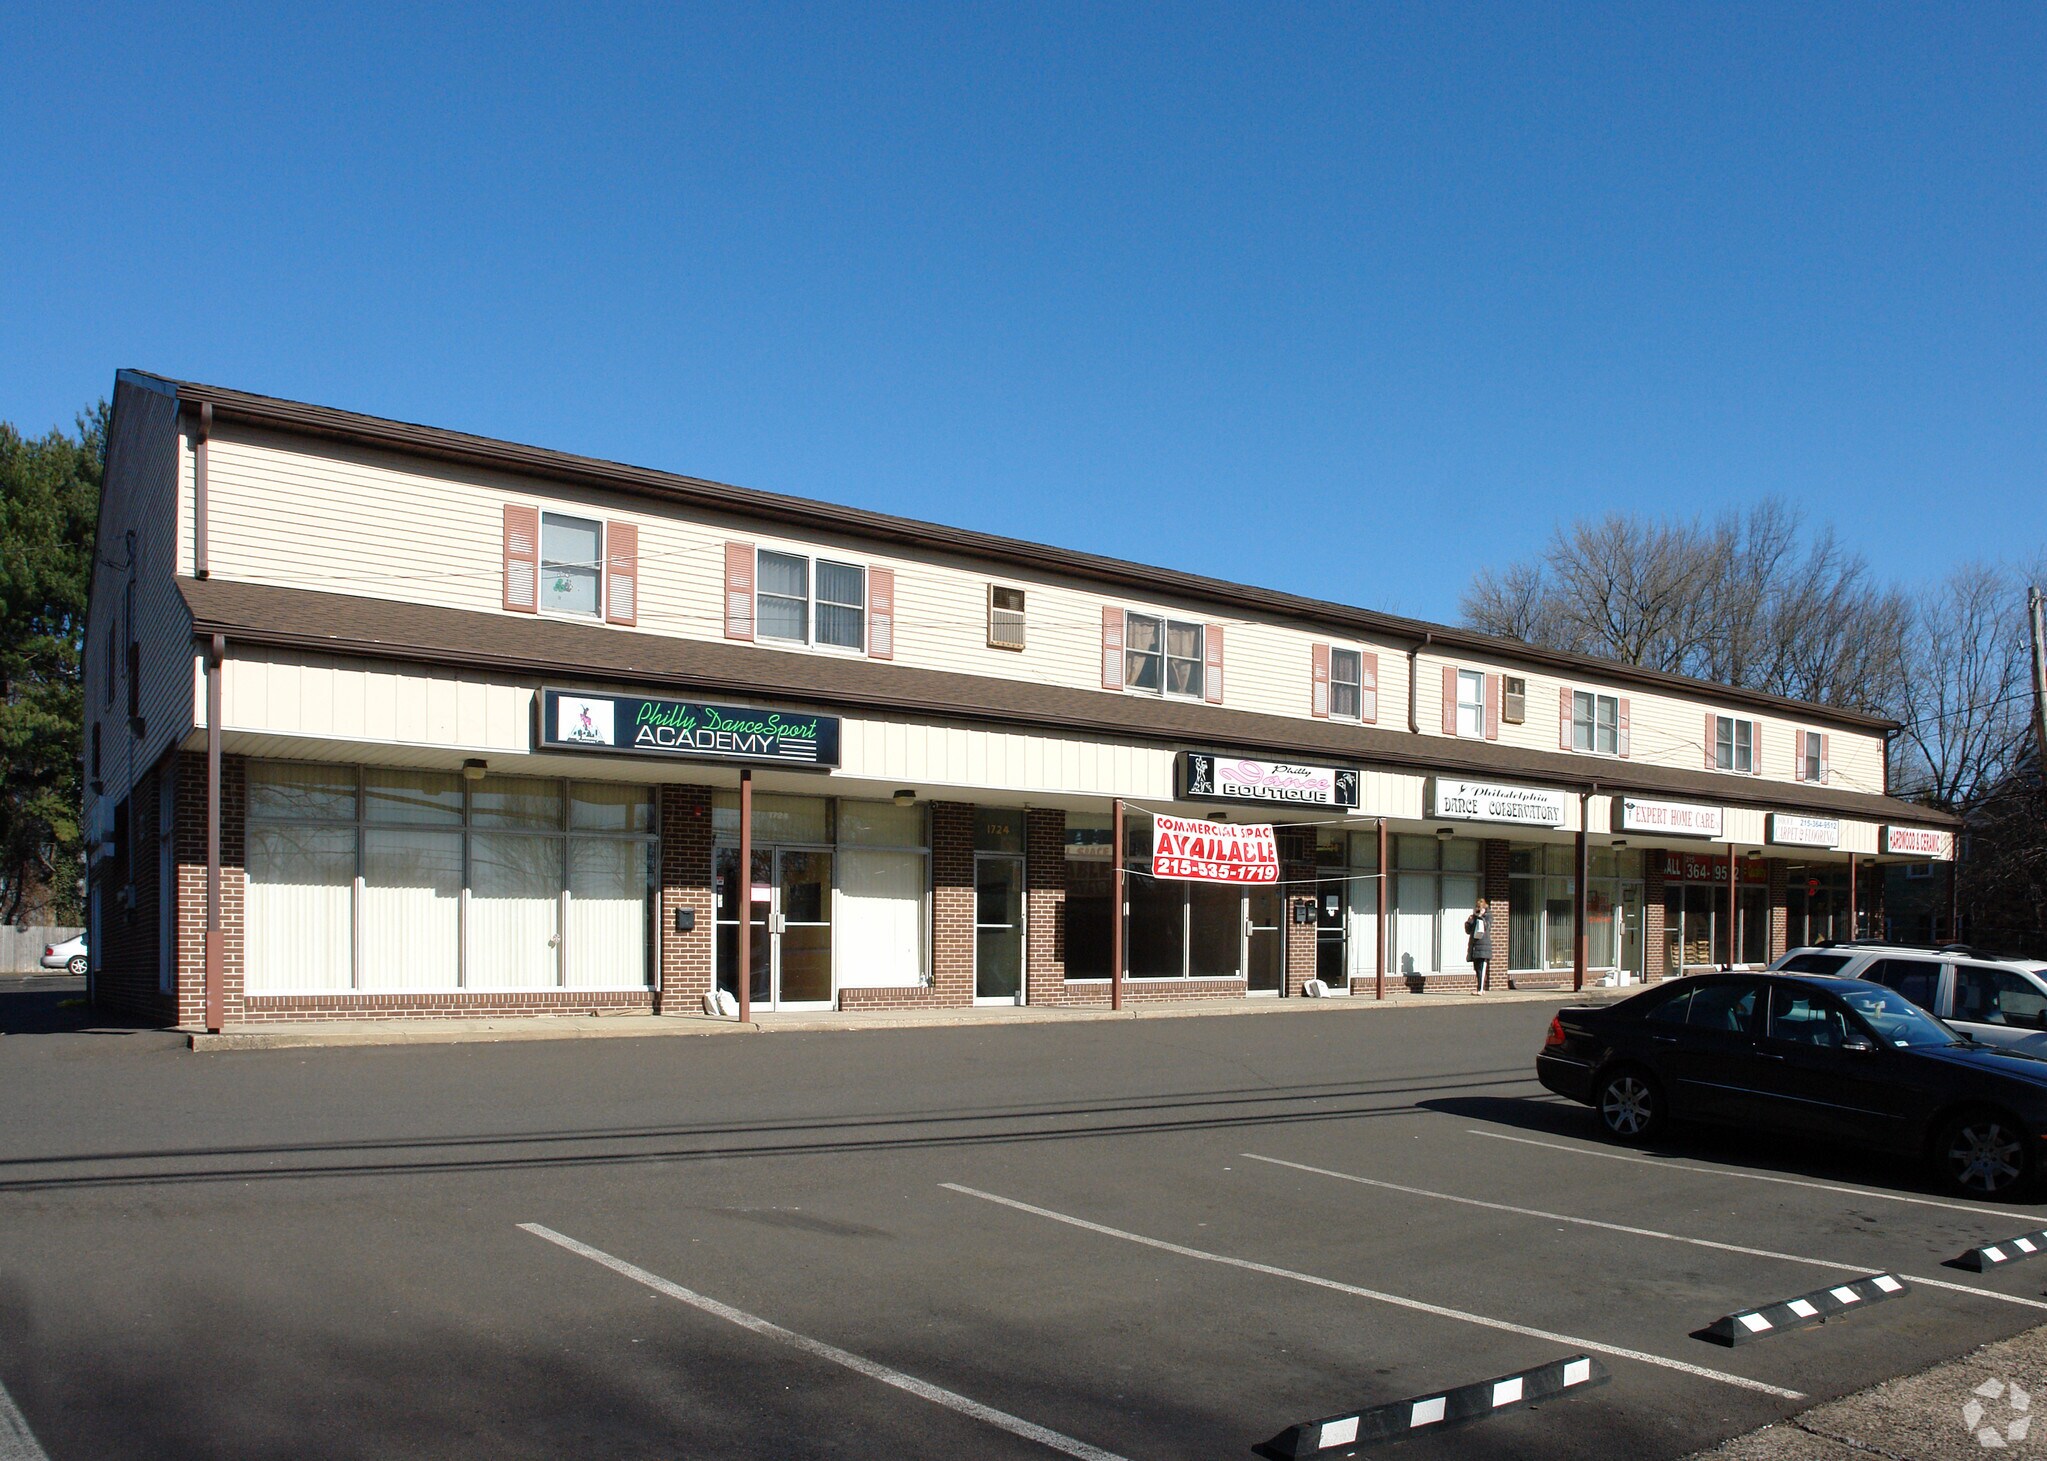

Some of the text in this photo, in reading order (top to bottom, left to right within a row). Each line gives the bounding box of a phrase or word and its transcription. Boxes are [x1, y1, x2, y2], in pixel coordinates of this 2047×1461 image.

[636, 702, 817, 743] Philly DanceSport
[635, 725, 774, 752] ACADEMY
[1219, 760, 1331, 790] Dance
[1271, 765, 1311, 777] Philly
[1223, 783, 1327, 802] BOUTIQUE
[1471, 786, 1548, 802] Philadelphia
[1444, 797, 1478, 814] DANCE
[1636, 806, 1668, 825] EXPERT
[1671, 809, 1692, 827] HOME
[1696, 812, 1716, 829] CARE
[988, 824, 1010, 835] 1724
[1157, 832, 1276, 863] AVAILABLE
[1156, 858, 1275, 880] 215-535-1719
[1664, 857, 1681, 876] ALL
